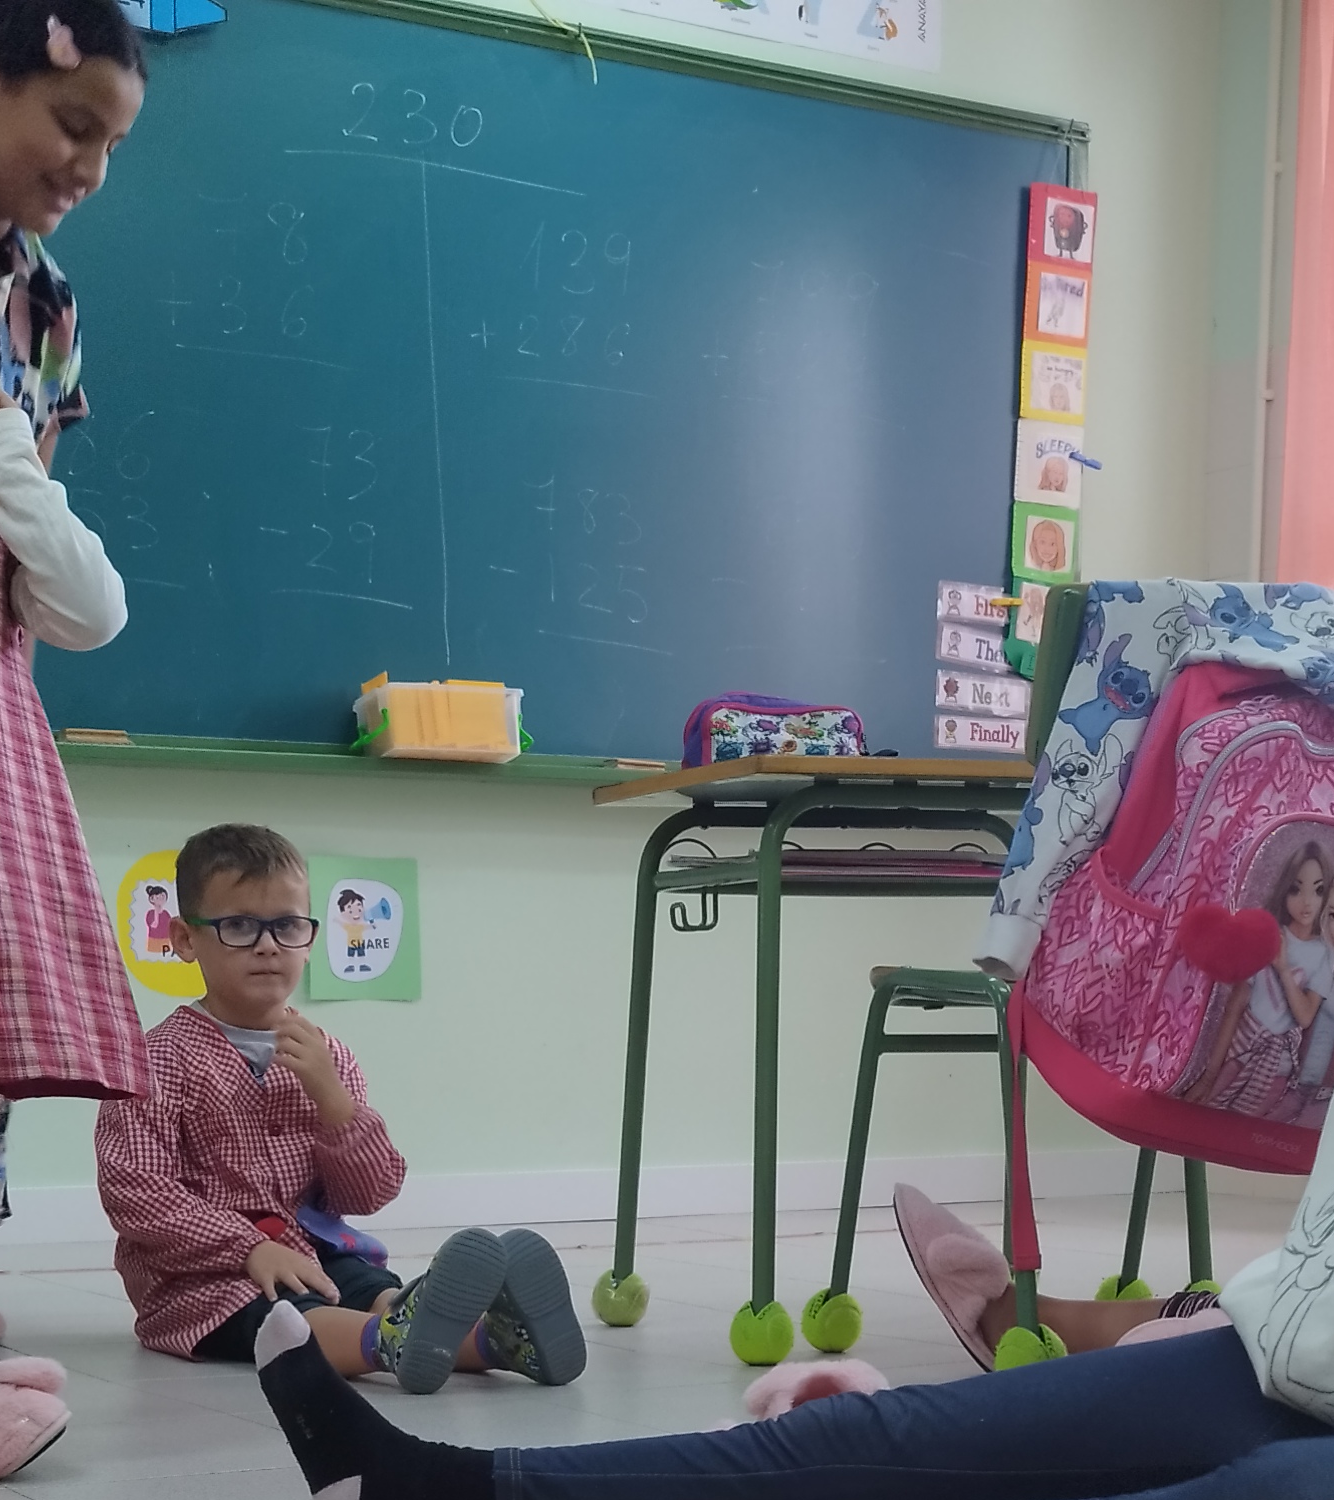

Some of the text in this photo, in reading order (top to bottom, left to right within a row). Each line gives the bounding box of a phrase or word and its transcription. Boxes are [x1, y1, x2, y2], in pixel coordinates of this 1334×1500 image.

[341, 82, 484, 147] 230
[296, 425, 379, 501] 73
[521, 473, 643, 548] 783
[974, 594, 1006, 619] Firs
[971, 683, 1011, 708] Next
[969, 722, 1021, 749] Finally
[350, 937, 390, 951] SHARE
